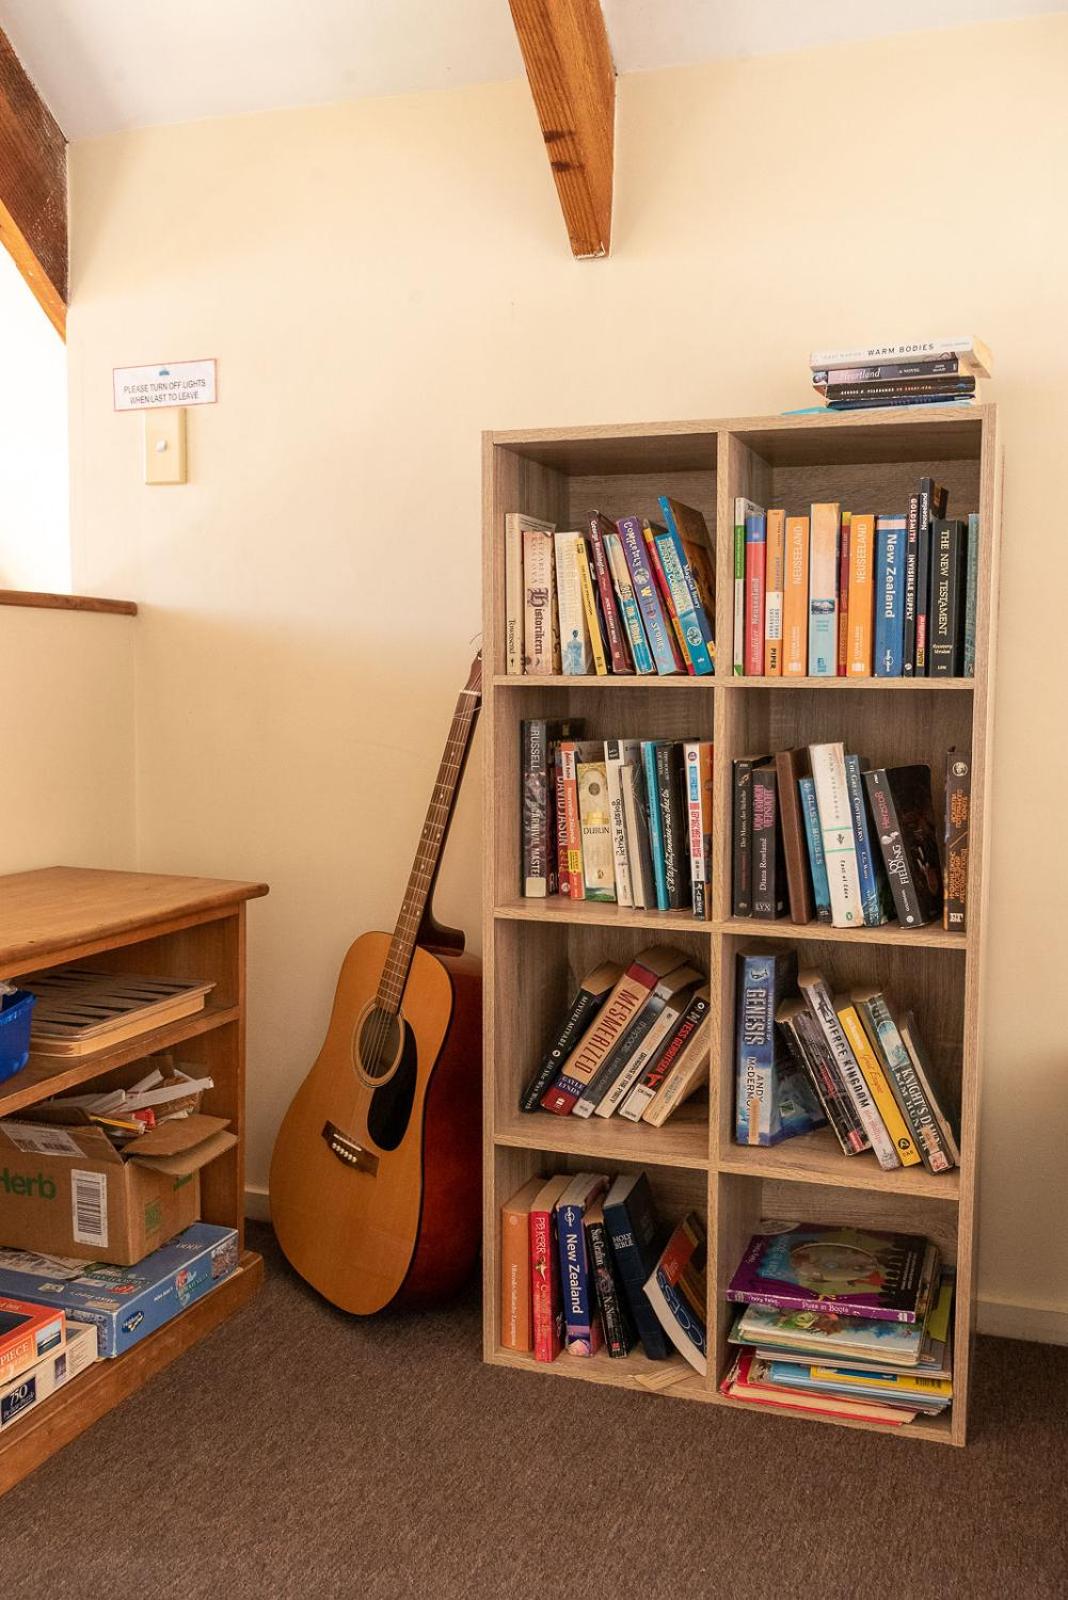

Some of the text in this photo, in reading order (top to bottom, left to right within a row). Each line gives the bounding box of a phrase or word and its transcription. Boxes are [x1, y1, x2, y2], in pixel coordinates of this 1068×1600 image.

[867, 347, 895, 357] WARM
[899, 343, 935, 353] BODIES
[123, 379, 206, 394] PLEASE TURN OFF LIGHTS
[130, 391, 199, 405] WHEN LAST TO LEAVE
[792, 526, 803, 585] NEUSEELAND
[856, 524, 867, 584] NEUSEELAND
[906, 498, 918, 621] GOLDSMITH INVISIBLE SUPPLY
[884, 534, 898, 619] New Zealand
[938, 530, 950, 636] THE NEW TESTAMENT
[531, 729, 540, 772] RUSSELL
[557, 776, 569, 846] DAVID JASON
[807, 795, 818, 823] GLASS
[583, 827, 610, 835] DUBLIN
[759, 838, 767, 891] Diana Rowland
[892, 844, 909, 885] FIELDING
[557, 1020, 576, 1047] MIYABE
[575, 989, 639, 1073] MESMERIZED
[678, 1020, 694, 1039] TESS
[745, 988, 767, 1046] GENESIS
[827, 1019, 848, 1057] FIERCE
[844, 1058, 871, 1108] KINGDOM
[756, 1075, 764, 1103] ANDY
[901, 1067, 928, 1115] KNIGHT'S
[535, 1231, 546, 1253] KERR
[591, 1228, 603, 1266] Sue Grafton
[613, 1232, 633, 1244] HOLY
[615, 1239, 634, 1250] BIBLE
[566, 1234, 583, 1315] New Zealand
[10, 1384, 28, 1406] 750
